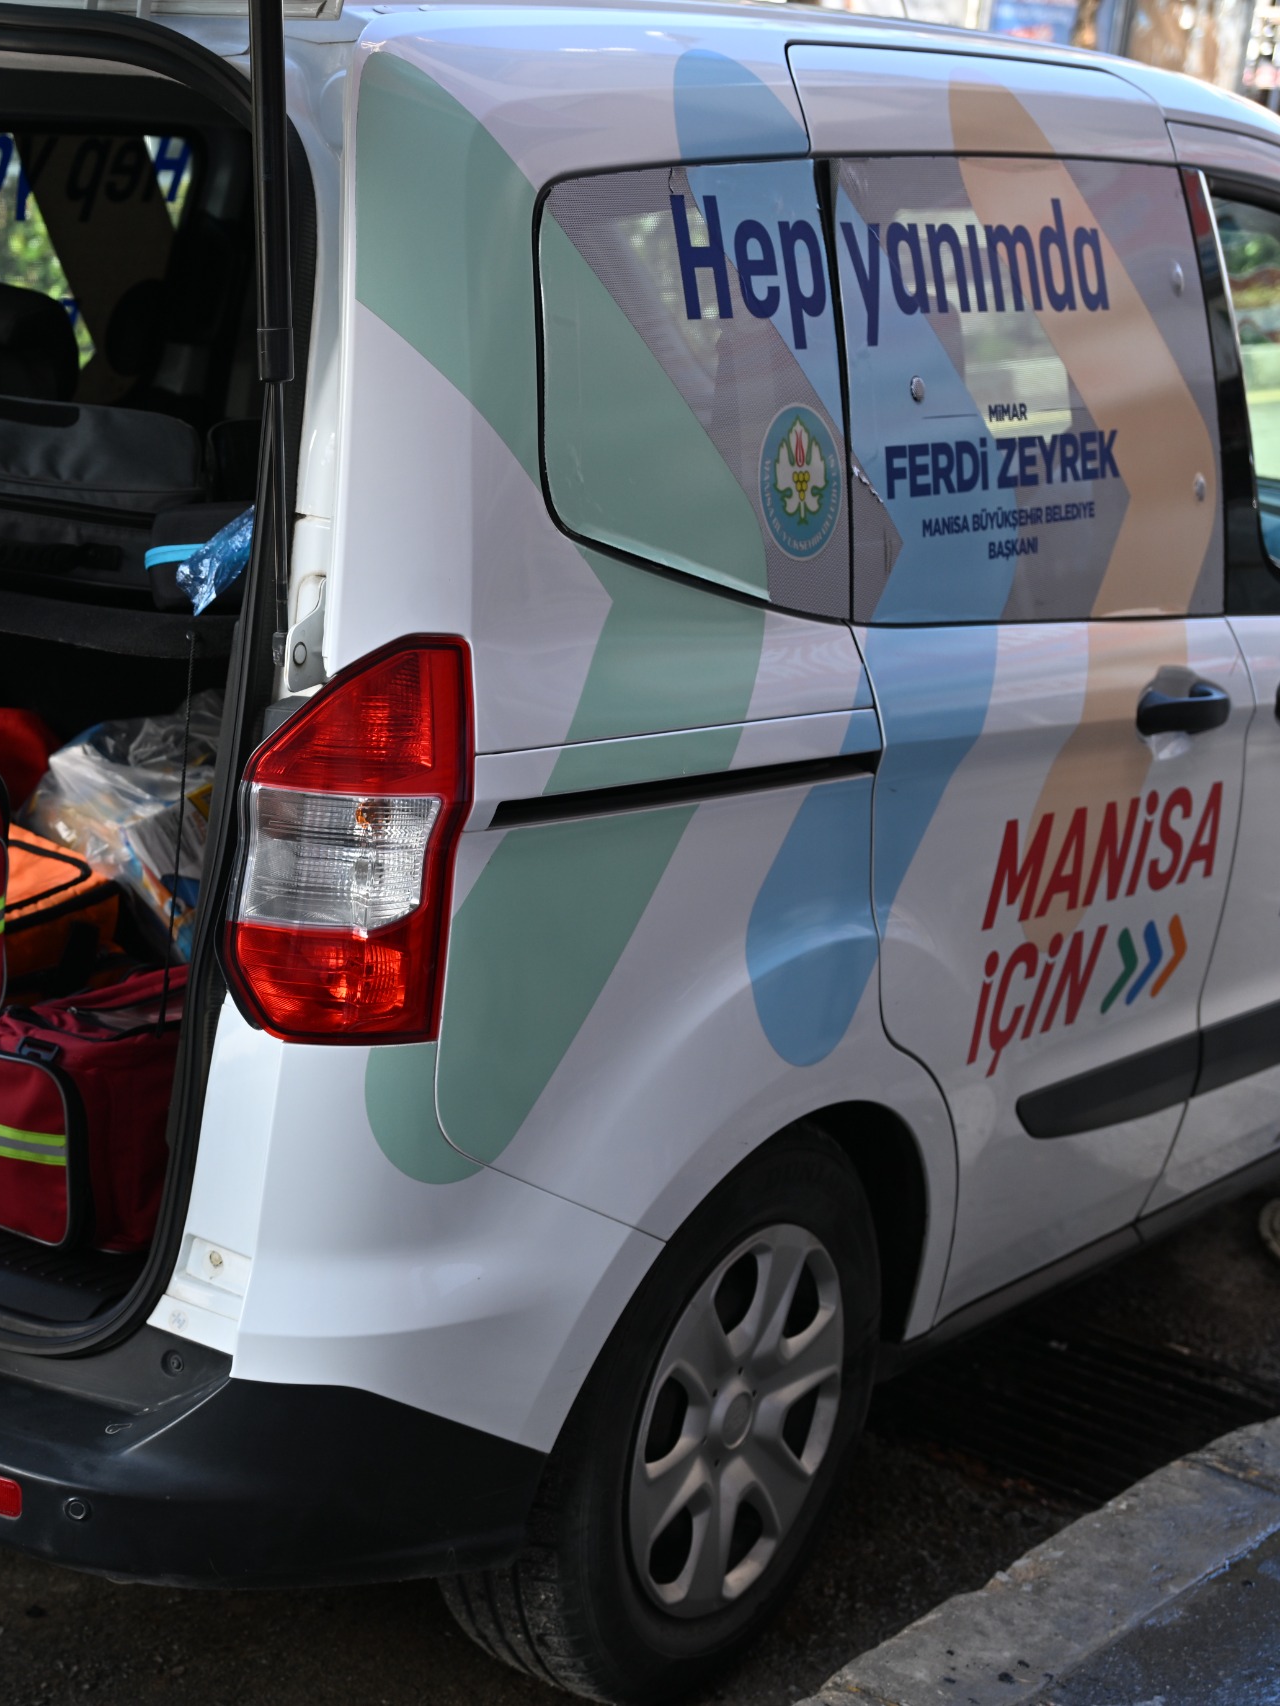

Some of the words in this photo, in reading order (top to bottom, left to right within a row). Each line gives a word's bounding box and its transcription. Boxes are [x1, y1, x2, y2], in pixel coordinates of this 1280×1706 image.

[670, 195, 827, 349] Hep
[840, 198, 1110, 347] yanımda
[995, 429, 1120, 490] ZEYREK
[988, 536, 1039, 561] BAŞKANI
